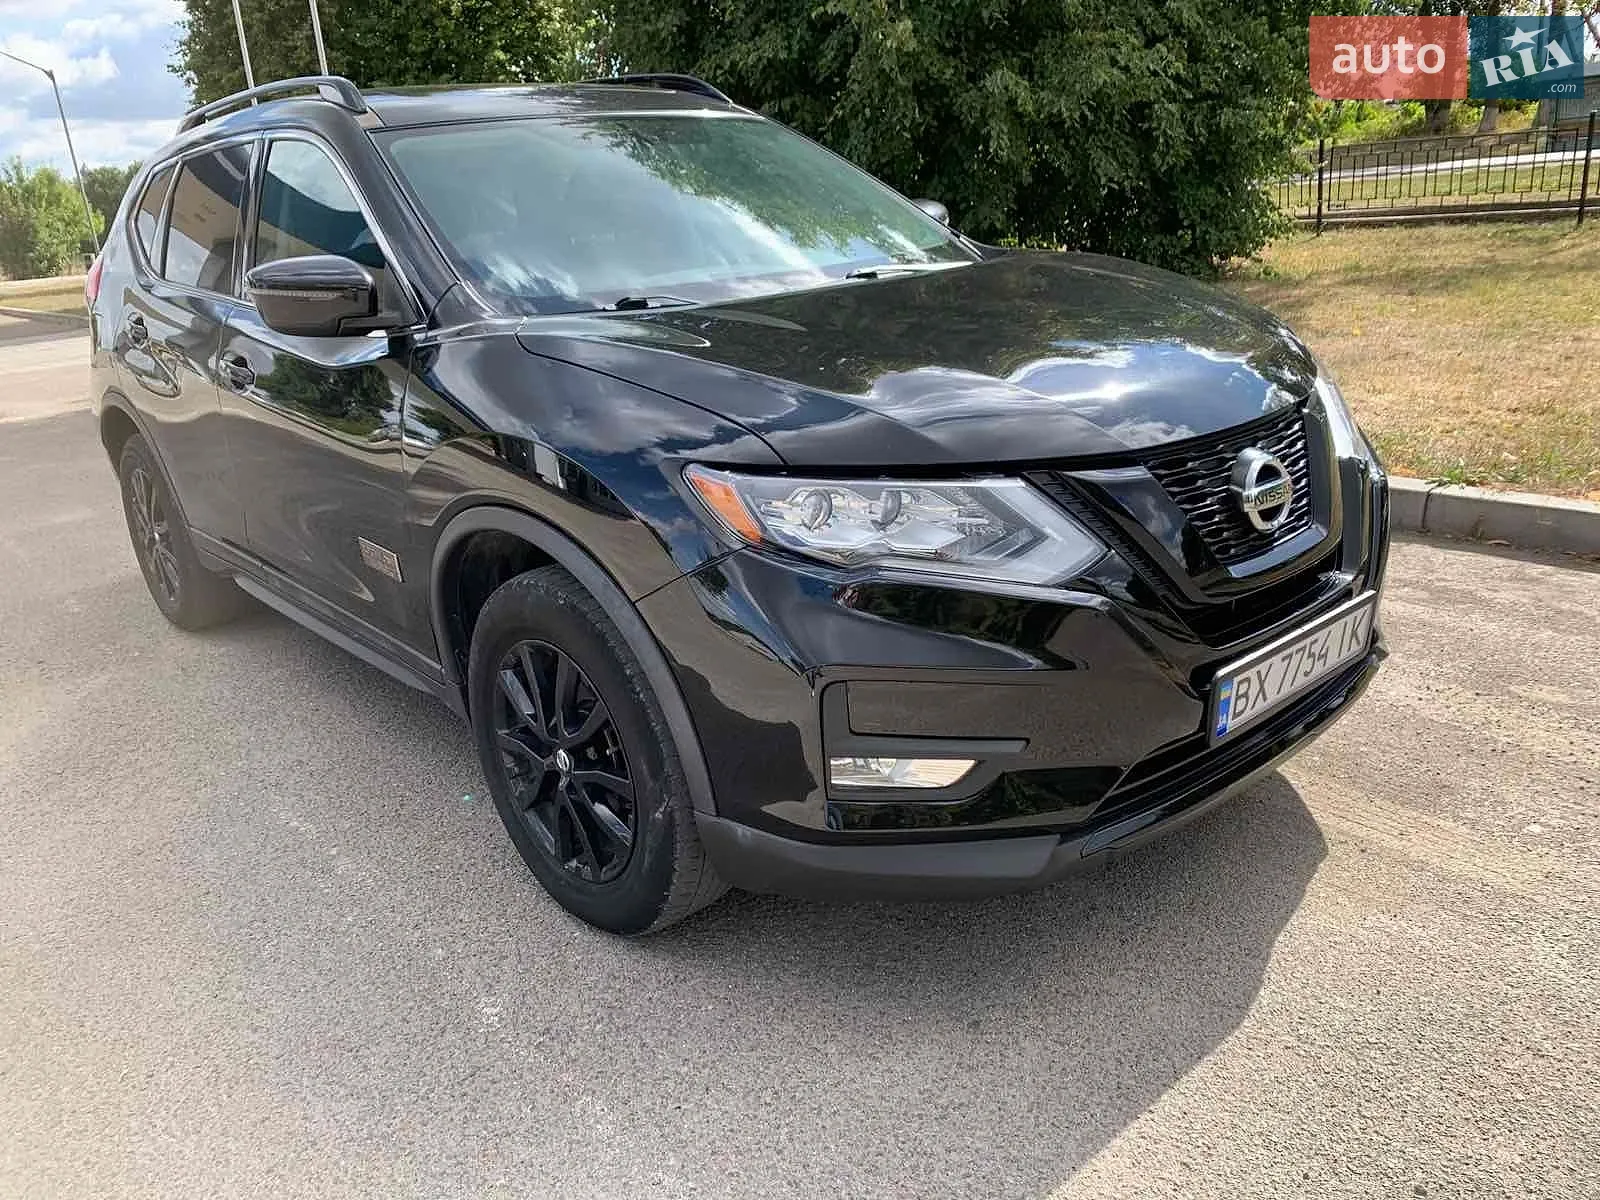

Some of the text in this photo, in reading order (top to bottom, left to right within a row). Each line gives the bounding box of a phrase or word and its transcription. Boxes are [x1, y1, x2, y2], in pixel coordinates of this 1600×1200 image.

[1231, 607, 1368, 721] BX 7754 IK
